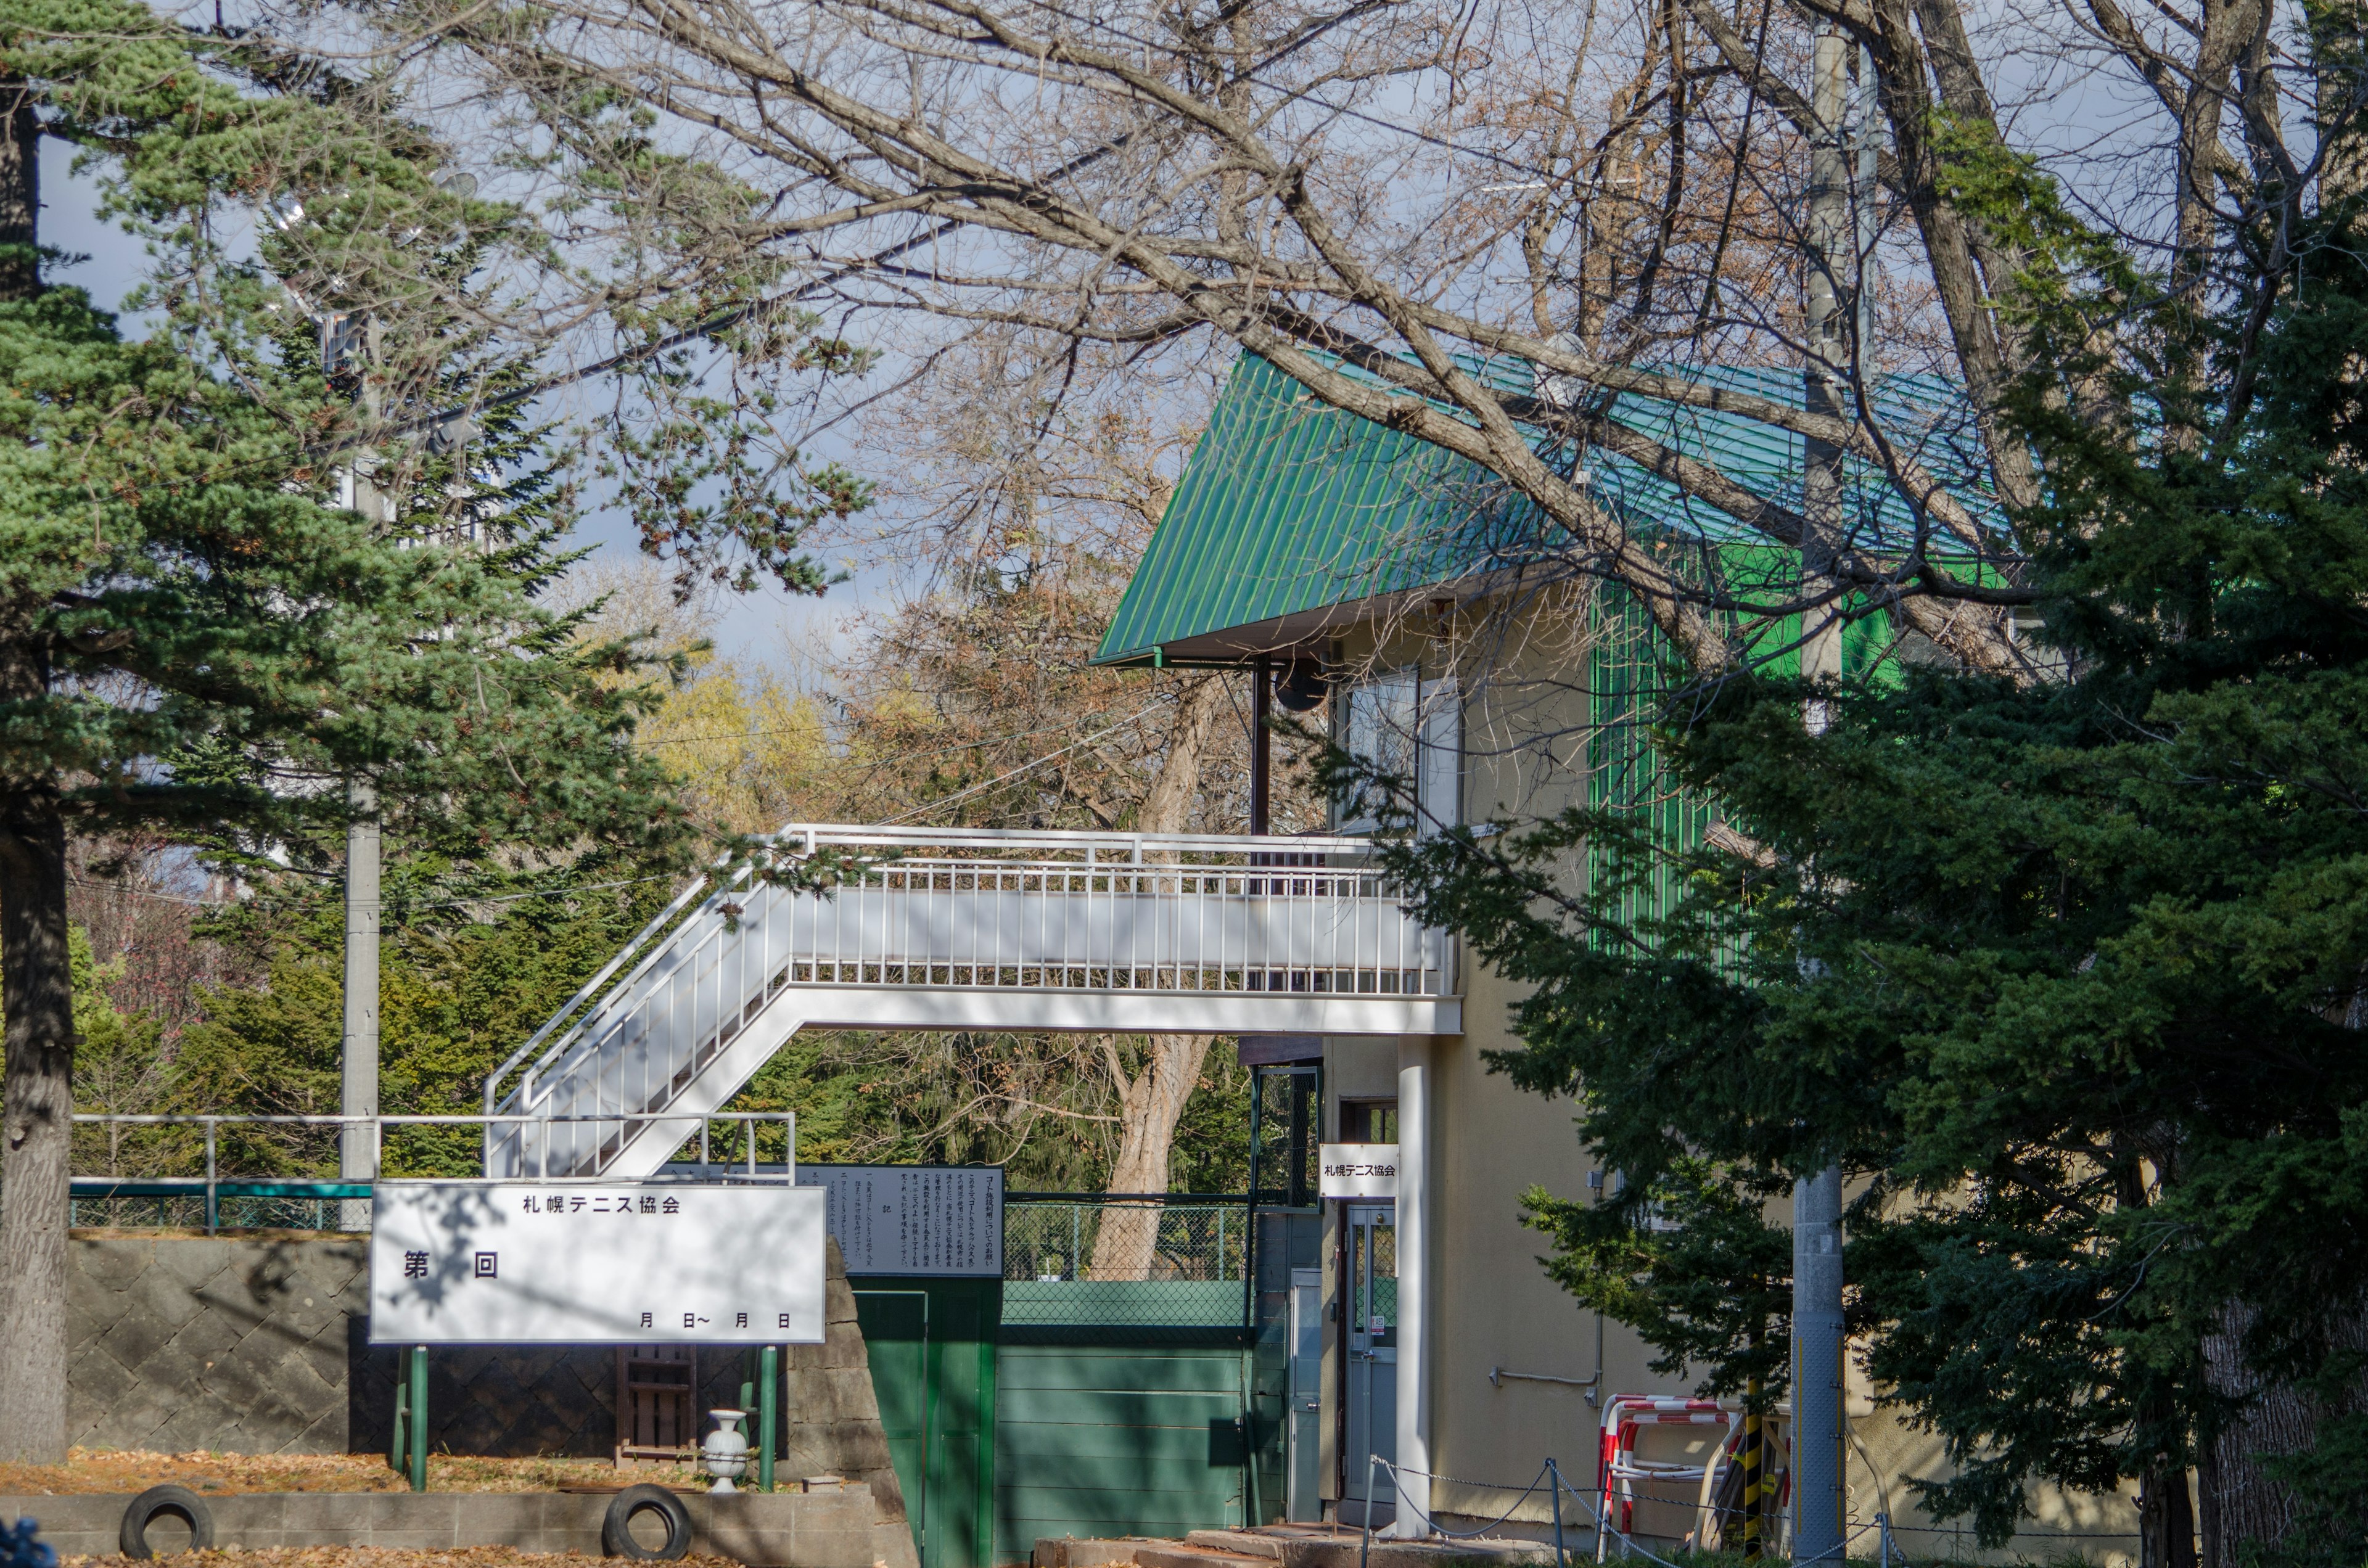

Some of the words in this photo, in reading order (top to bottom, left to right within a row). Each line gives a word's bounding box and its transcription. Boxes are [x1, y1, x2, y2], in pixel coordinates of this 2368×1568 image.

[1324, 1164, 1396, 1177] 札幌テニス協会
[523, 1195, 680, 1214] 札幌テニス協会
[882, 1204, 892, 1213] 記
[984, 1176, 995, 1267] コート施設利用についてのお願い
[404, 1250, 430, 1279] 第
[475, 1251, 498, 1279] 回
[640, 1312, 652, 1328] 月
[736, 1312, 748, 1328] 月
[779, 1313, 790, 1329] 日
[1376, 1318, 1384, 1326] AED
